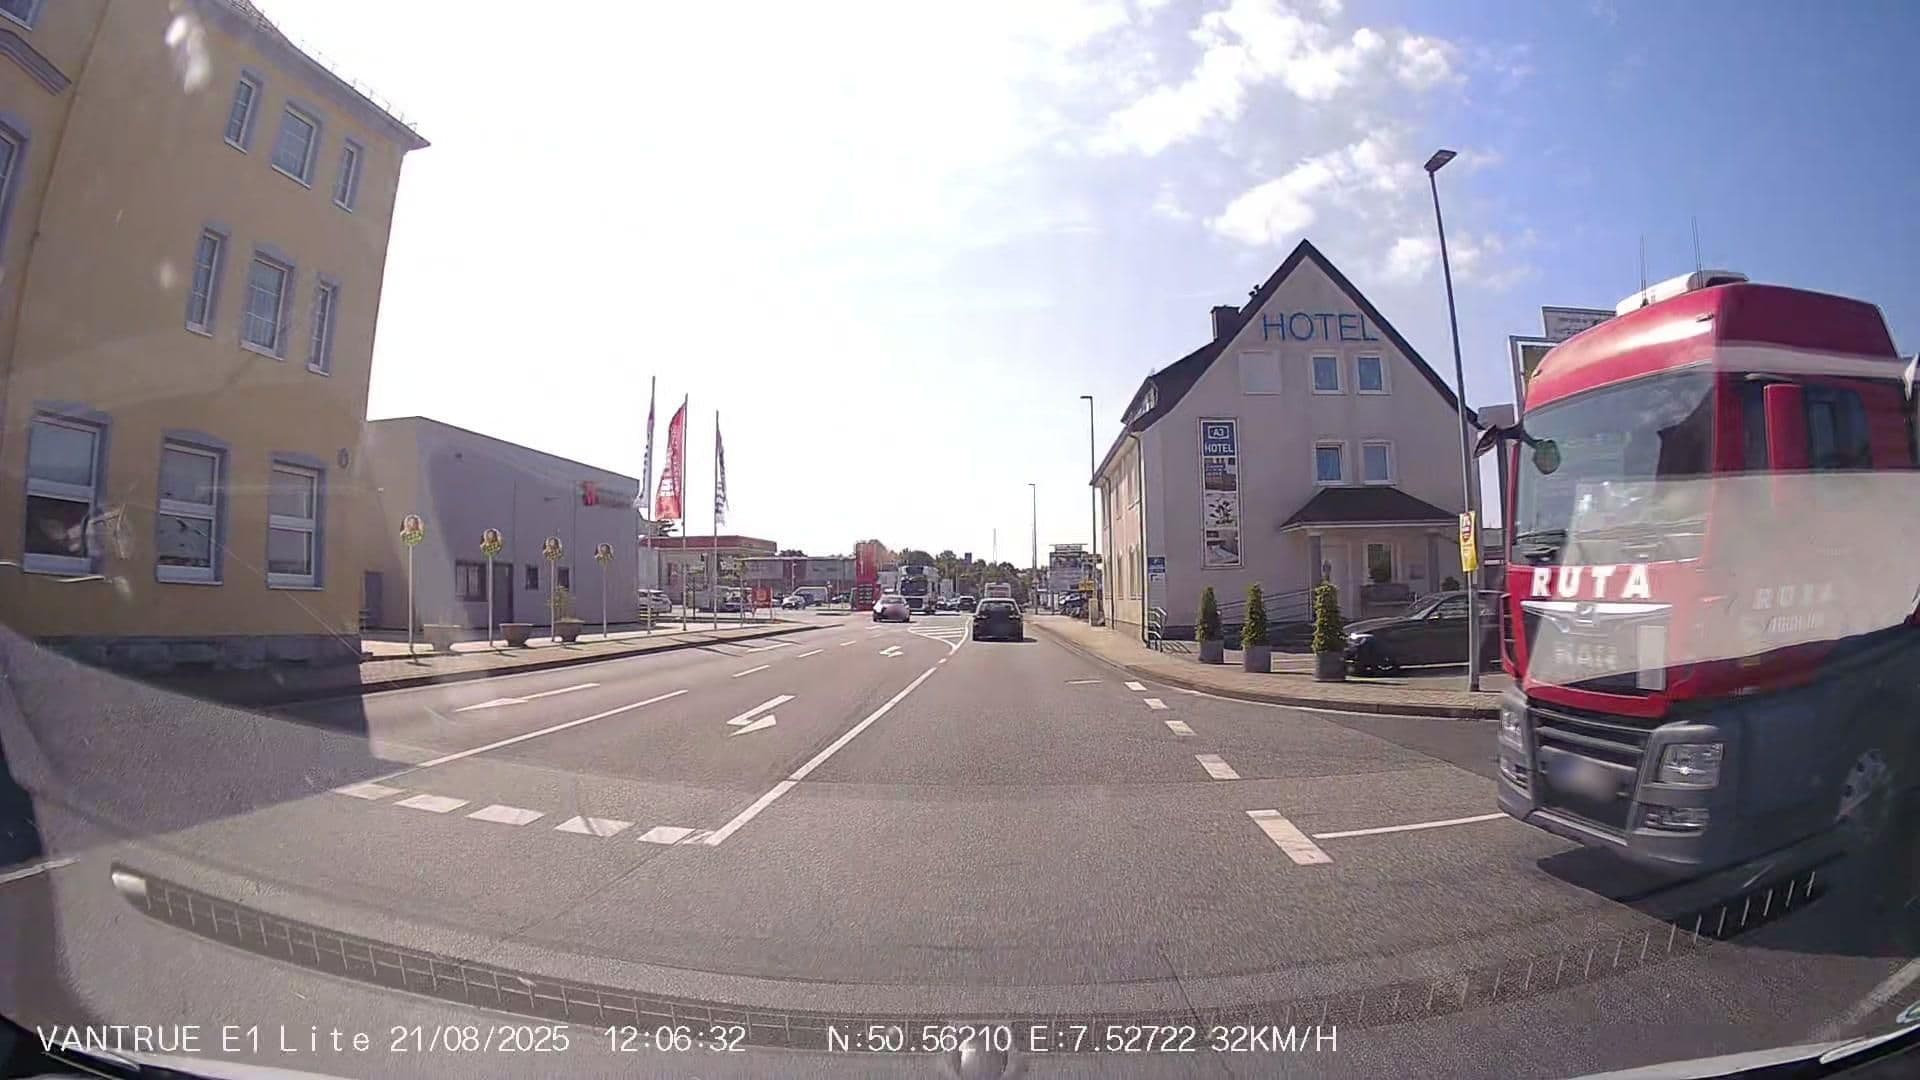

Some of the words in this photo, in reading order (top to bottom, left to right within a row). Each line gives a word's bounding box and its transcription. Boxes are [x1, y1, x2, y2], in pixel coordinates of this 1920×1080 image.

[1262, 312, 1379, 341] HOTEL
[1205, 443, 1234, 453] HOTEL
[1531, 563, 1651, 599] RUTA
